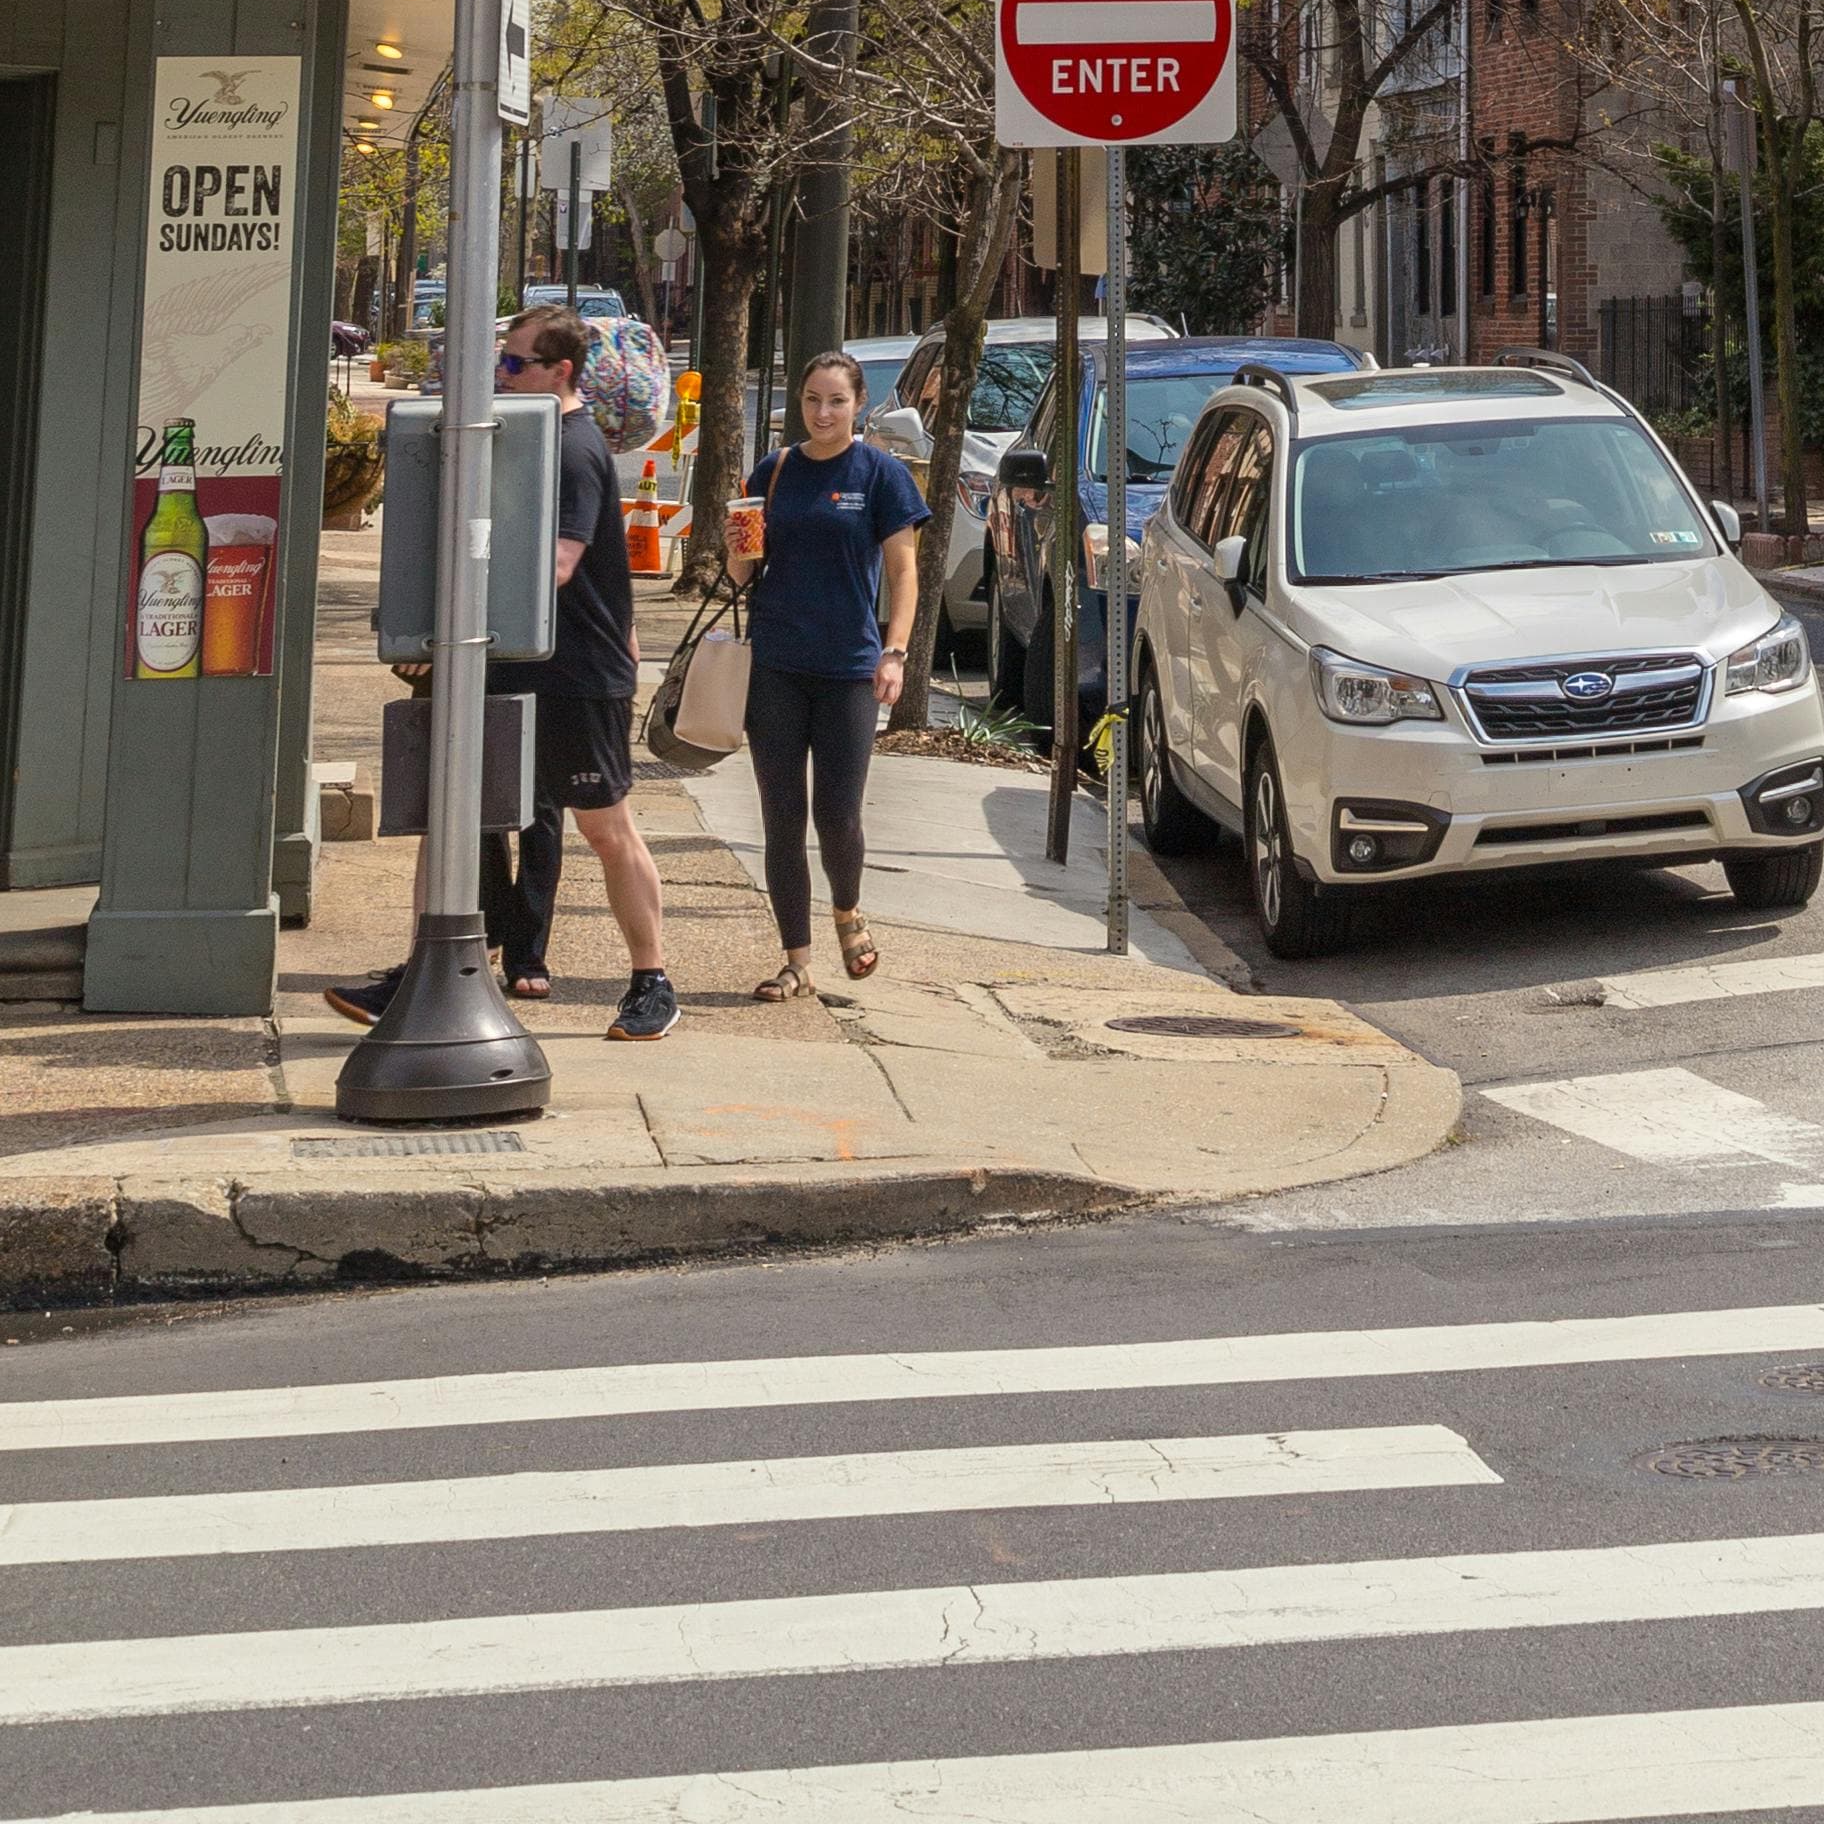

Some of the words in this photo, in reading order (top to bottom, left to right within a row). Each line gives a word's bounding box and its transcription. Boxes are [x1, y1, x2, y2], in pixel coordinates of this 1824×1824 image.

[1051, 58, 1180, 94] ENTER
[164, 97, 289, 131] Yuengling
[161, 164, 282, 218] OPEN
[159, 222, 280, 252] SUNDAYS!
[206, 583, 252, 597] AGER
[140, 620, 197, 637] LAGER
